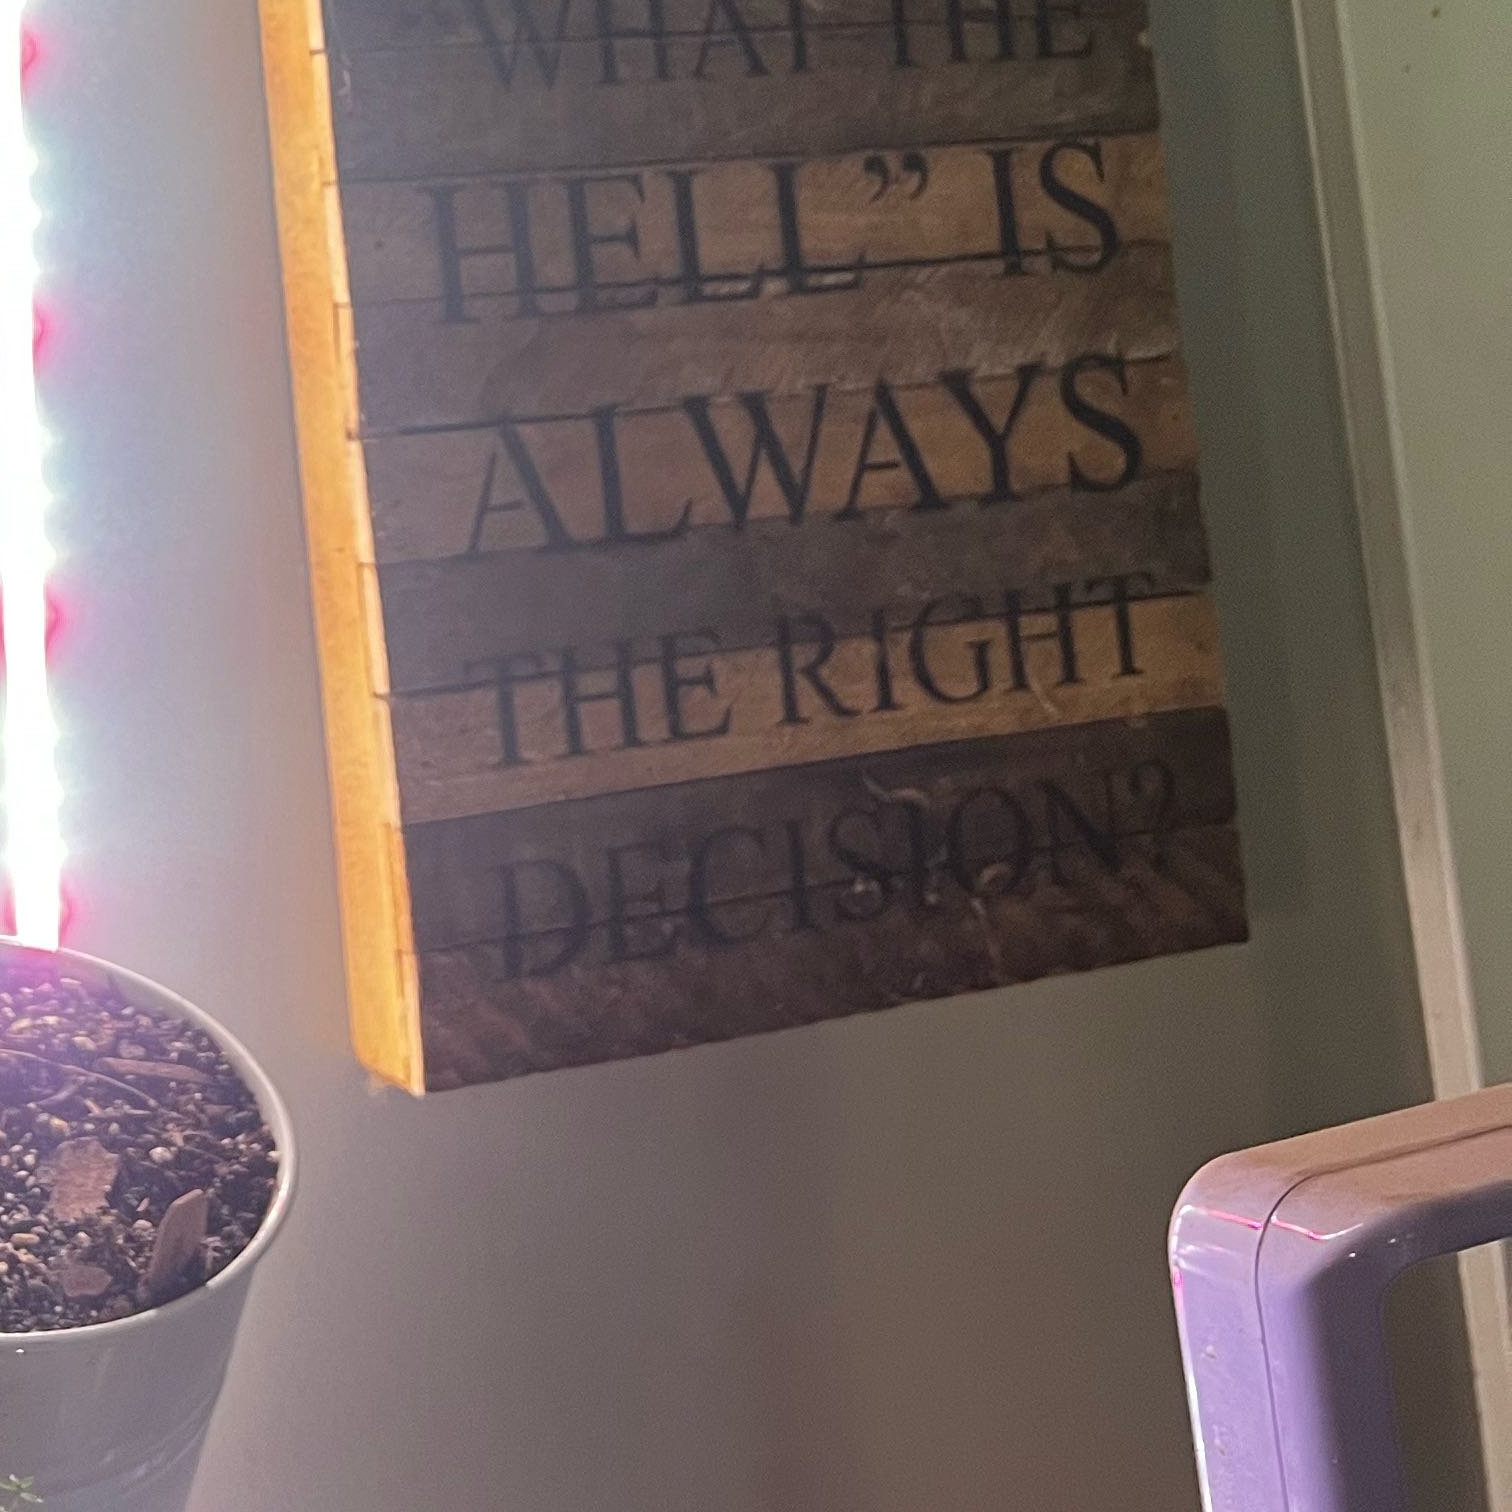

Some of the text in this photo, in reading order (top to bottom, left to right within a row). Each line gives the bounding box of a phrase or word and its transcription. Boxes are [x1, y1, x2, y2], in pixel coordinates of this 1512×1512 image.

[985, 139, 1122, 278] IS
[466, 351, 1145, 561] ALWAYS
[465, 572, 1157, 769] THE RIGHT
[495, 758, 1179, 981] DECISION?
